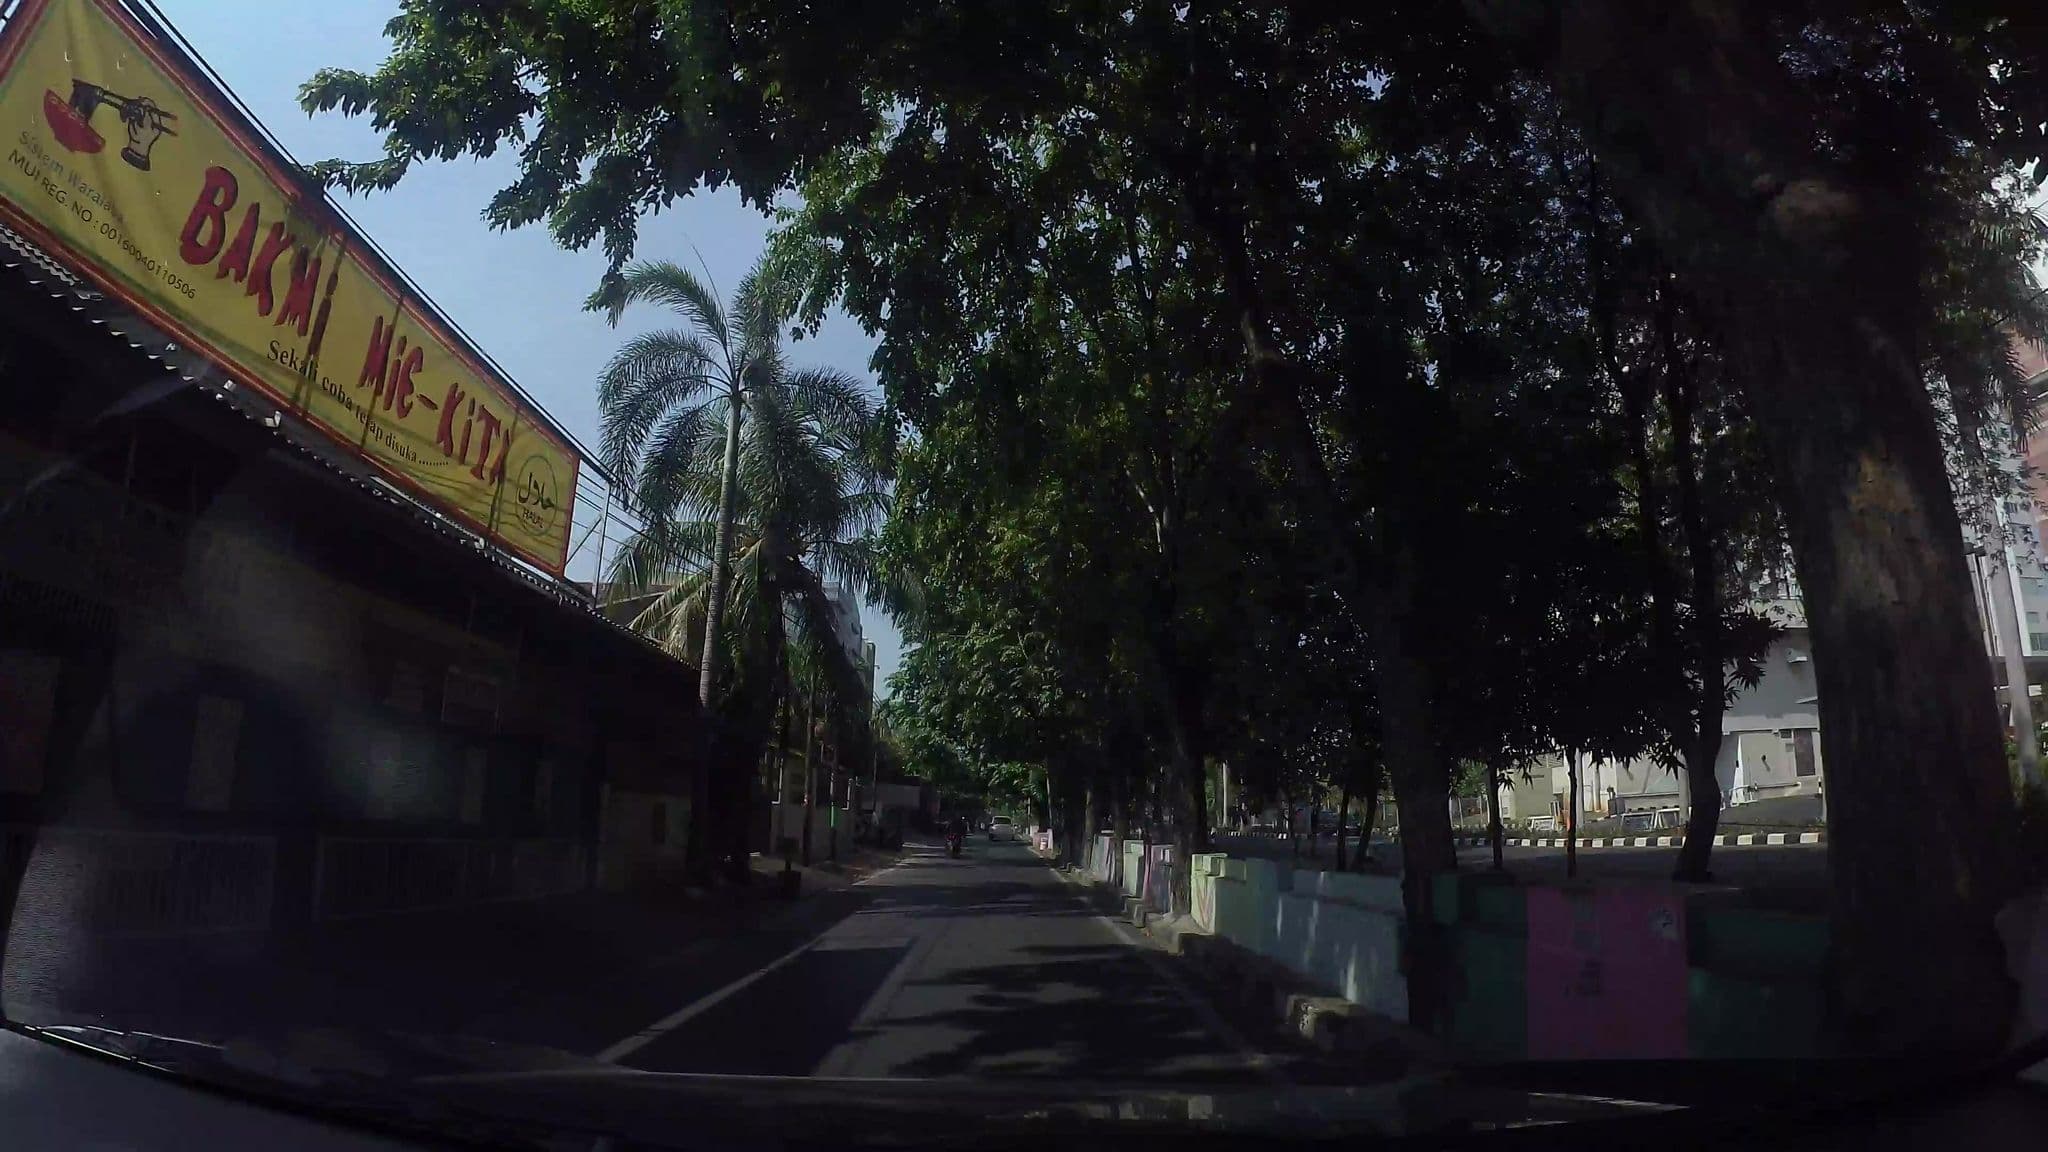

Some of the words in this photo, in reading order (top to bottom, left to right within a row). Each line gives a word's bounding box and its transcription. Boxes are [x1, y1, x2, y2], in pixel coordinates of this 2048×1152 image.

[8, 149, 41, 182] MUI
[41, 176, 68, 208] REG.
[71, 200, 93, 223] NO
[267, 340, 319, 384] Sekali
[322, 375, 353, 412] coba
[385, 428, 418, 464] disuka
